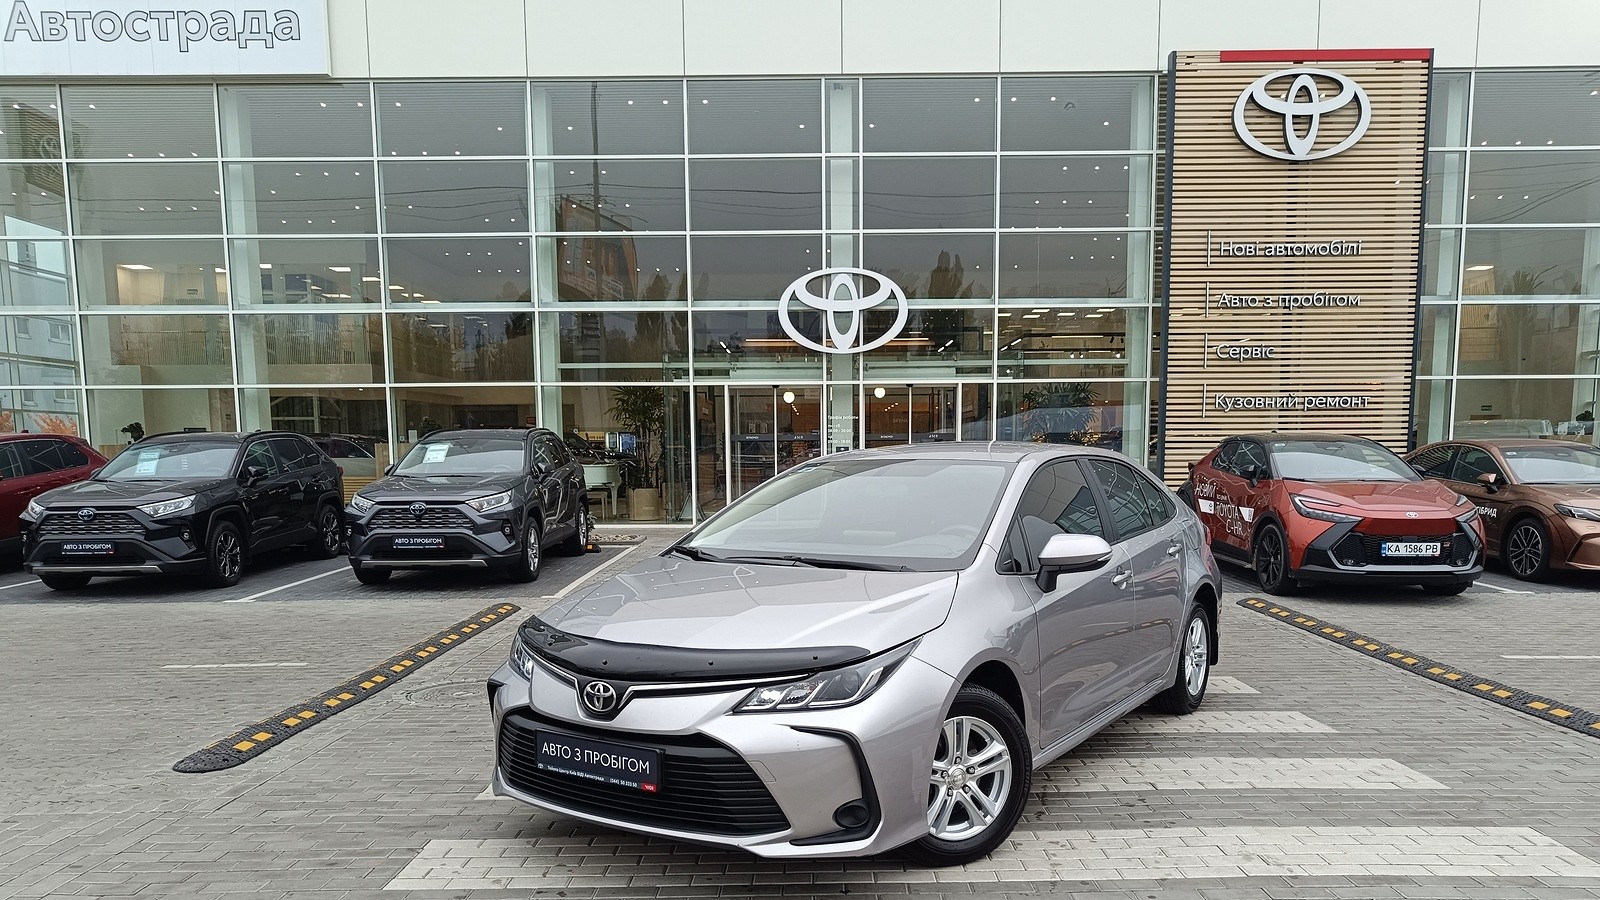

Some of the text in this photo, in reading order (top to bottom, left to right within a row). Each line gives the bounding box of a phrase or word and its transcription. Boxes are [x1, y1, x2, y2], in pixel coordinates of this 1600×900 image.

[4, 0, 301, 52] Автострада
[1219, 240, 1363, 256] Нові автомобілі
[1217, 291, 1361, 311] Авто з пробігом
[1216, 344, 1276, 362] Сервіс
[1214, 393, 1371, 412] Кузовний ремонт
[1215, 502, 1240, 520] TOYOTA
[1226, 519, 1244, 536] C-HR
[1404, 544, 1424, 553] 1586
[541, 741, 650, 775] АВТО З ПРОБІГОМ
